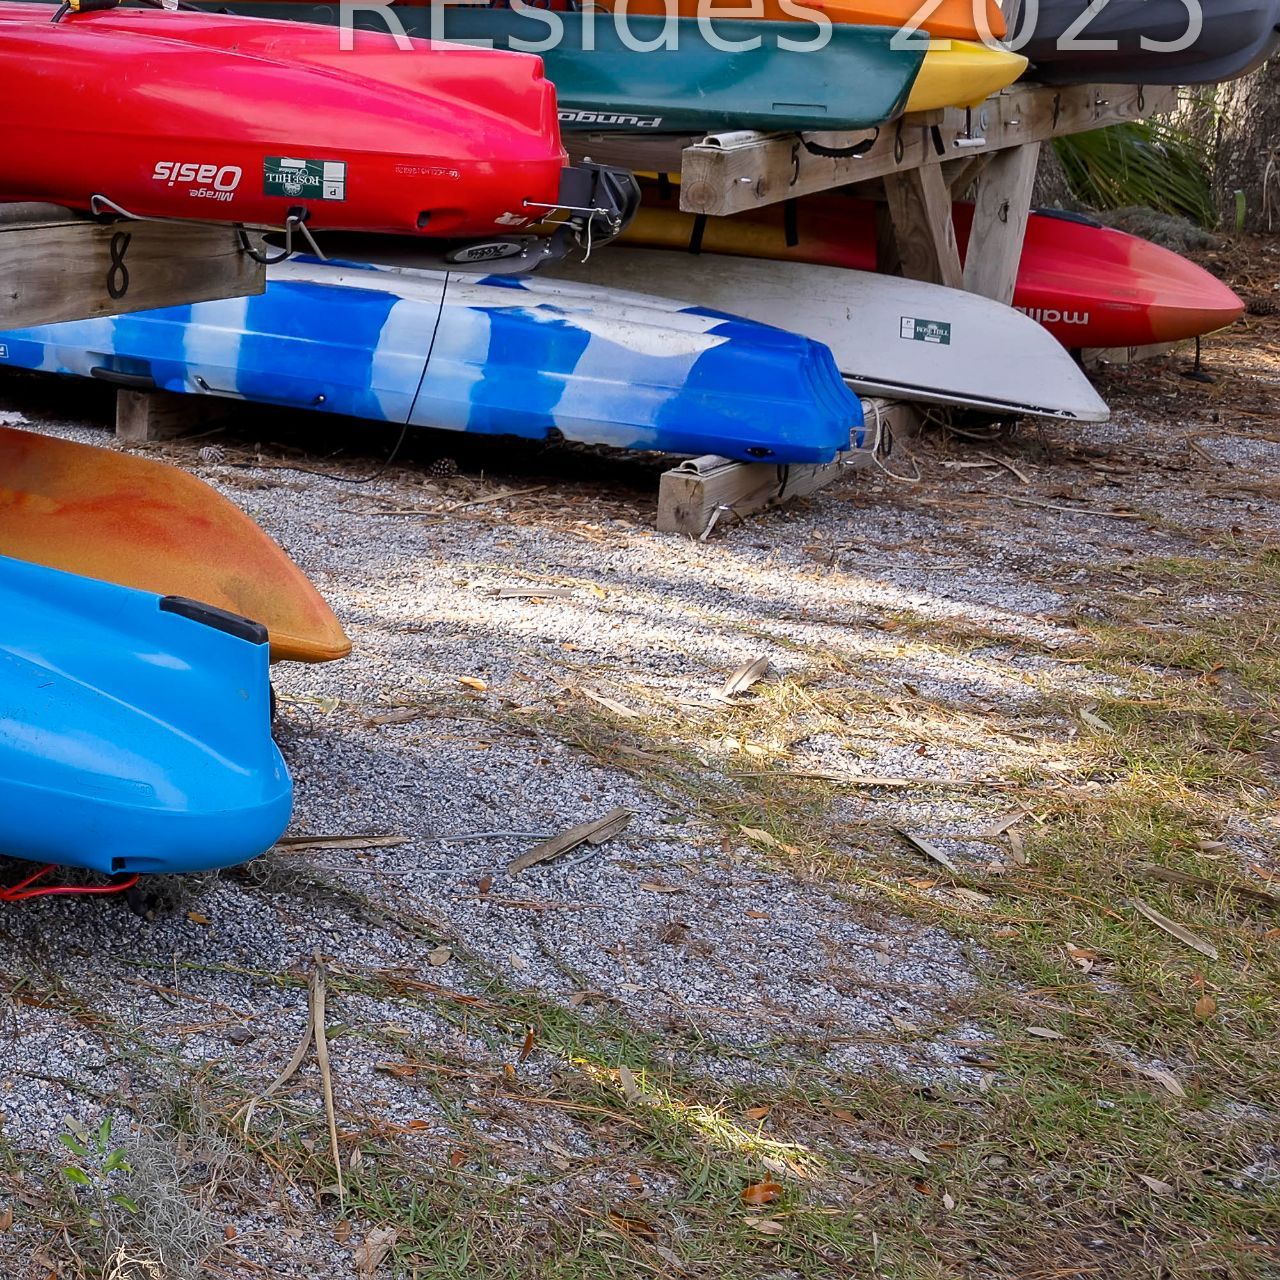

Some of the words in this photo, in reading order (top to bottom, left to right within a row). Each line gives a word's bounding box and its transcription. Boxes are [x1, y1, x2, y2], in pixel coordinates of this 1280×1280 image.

[558, 111, 662, 128] Pungo
[152, 161, 242, 191] Oasis
[265, 172, 292, 185] HILL
[292, 174, 320, 186] ROSE
[190, 189, 234, 202] Mirage
[107, 231, 132, 299] 8
